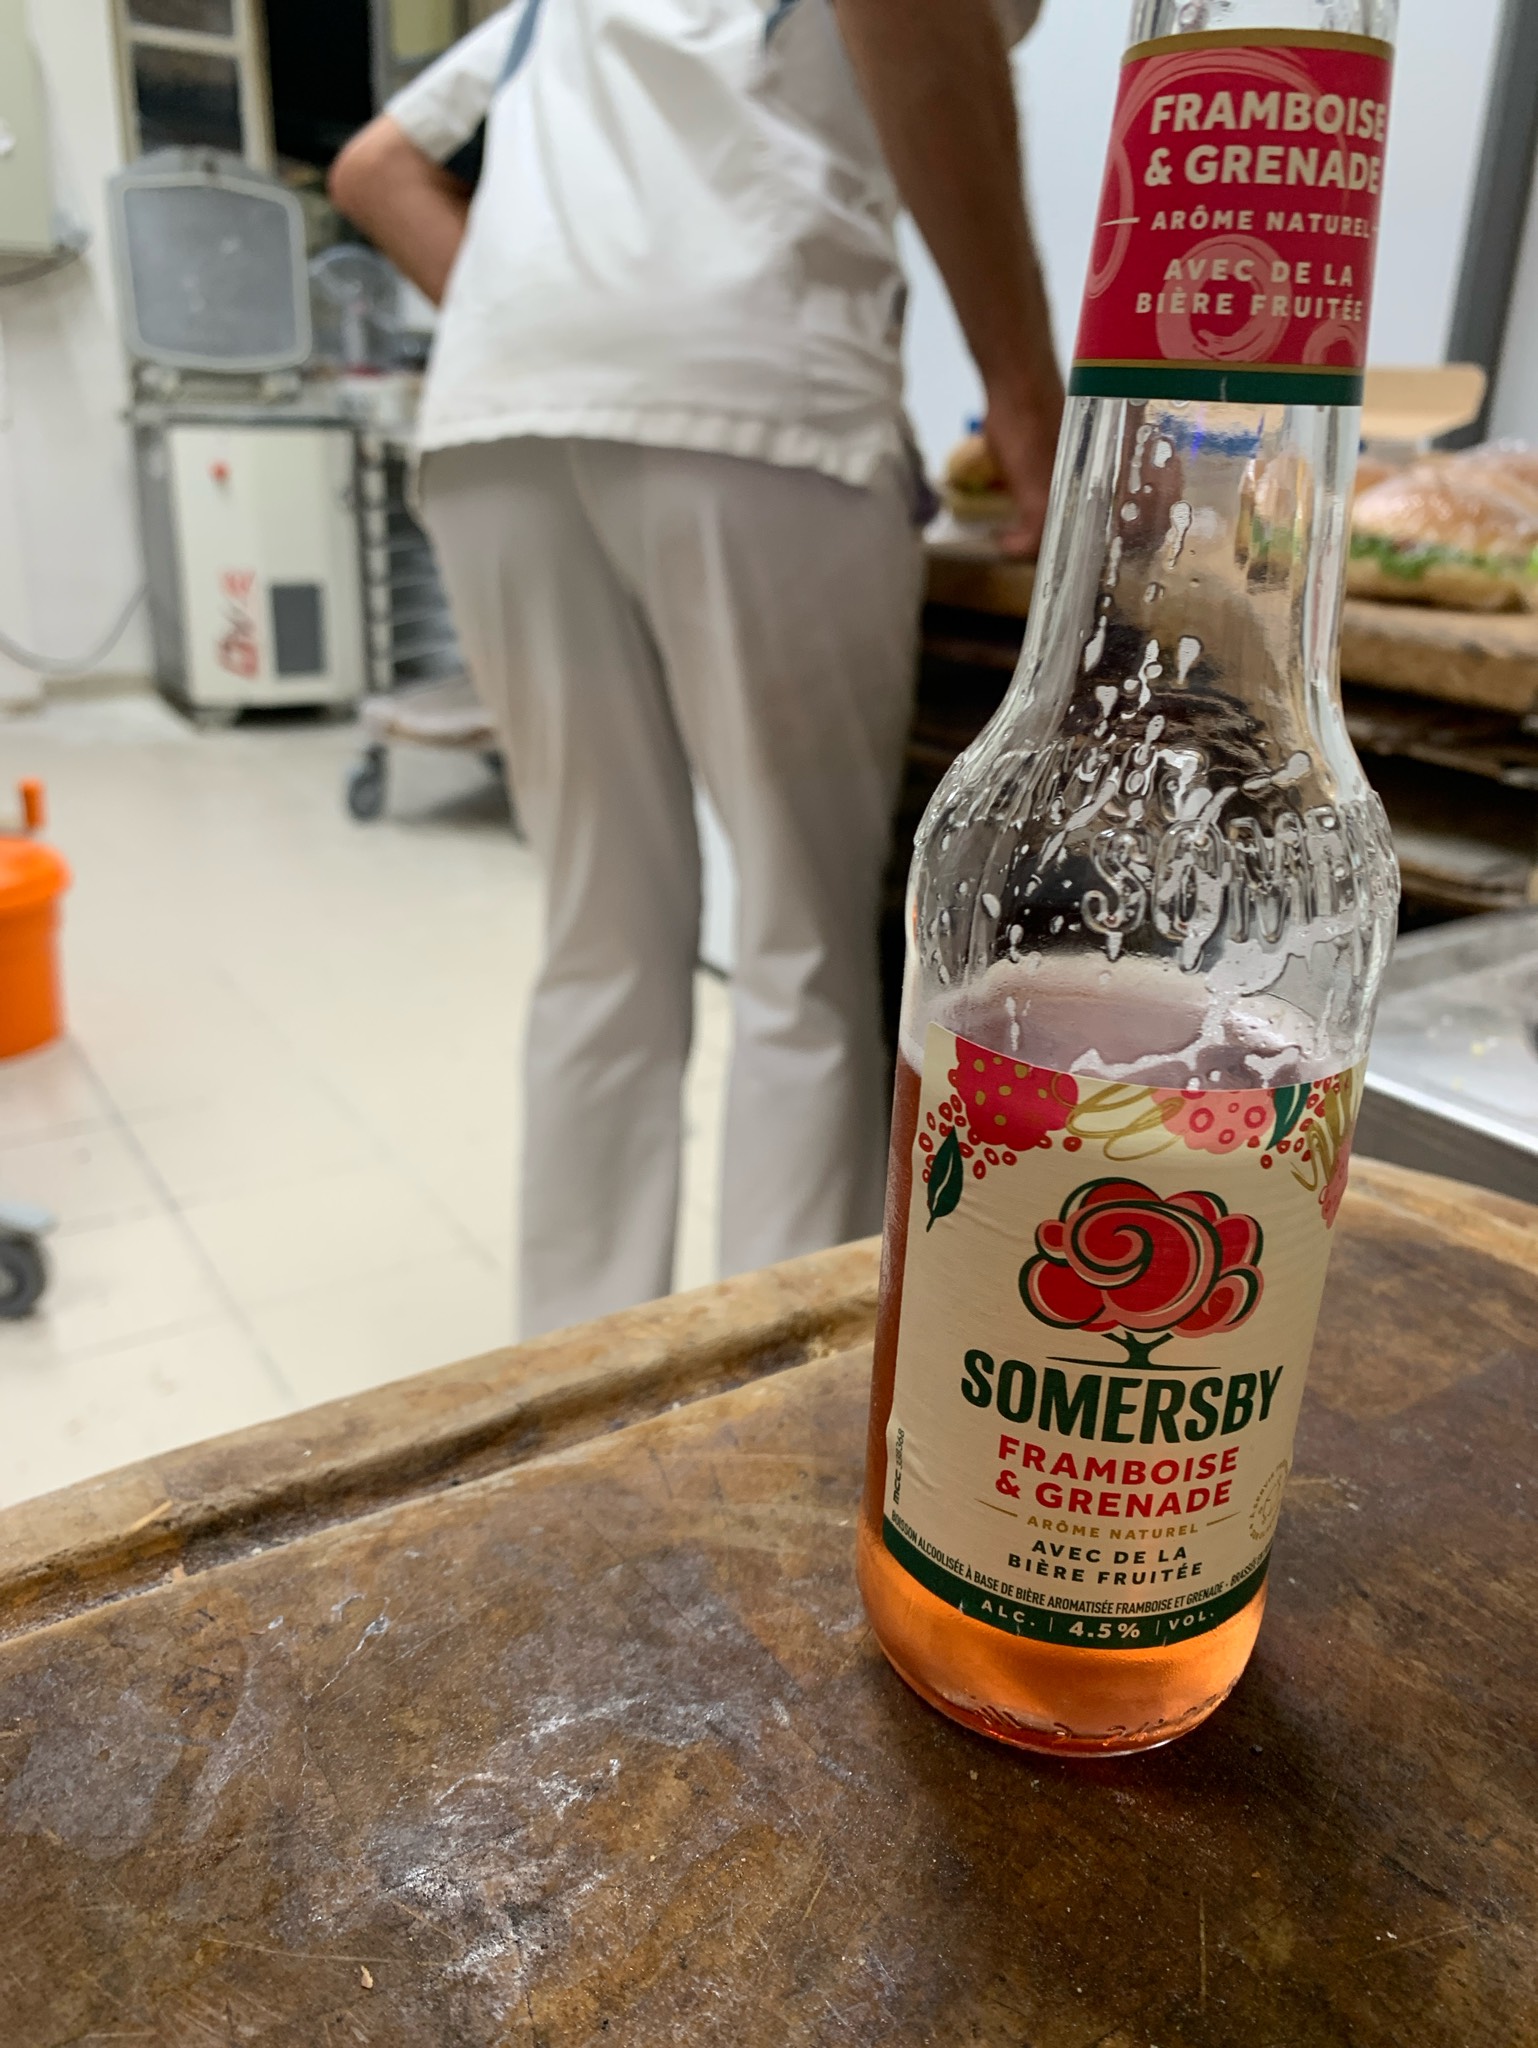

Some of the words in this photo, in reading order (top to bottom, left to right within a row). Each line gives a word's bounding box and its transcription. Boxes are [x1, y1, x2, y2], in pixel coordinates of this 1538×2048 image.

[1150, 91, 1387, 142] FRAMBOISE
[1144, 147, 1173, 187] &
[1184, 145, 1381, 195] GRENADE
[1151, 204, 1255, 231] ARÔME
[1266, 211, 1370, 238] NATUREL
[1163, 258, 1256, 282] AVEC
[1270, 260, 1312, 285] DE
[1323, 262, 1354, 288] LA
[1134, 286, 1235, 316] BIÈRE
[1250, 292, 1363, 323] FRUITÉE
[961, 1348, 1284, 1445] SOMERSBY
[998, 1434, 1240, 1486] FRAMBOISE
[995, 1469, 1021, 1500] &
[1034, 1479, 1233, 1518] GRENADE
[1027, 1515, 1100, 1539] ARÔME
[1109, 1523, 1199, 1541] NATUREL
[891, 1509, 918, 1545] BOISSON
[917, 1536, 964, 1576] ALCOOLISÉE
[965, 1563, 973, 1580] À
[974, 1570, 999, 1592] BASE
[1001, 1582, 1015, 1597] DE
[1015, 1587, 1047, 1606] BIÈRE
[1047, 1594, 1114, 1615] AROMATISÉE
[1115, 1597, 1173, 1615] FRAMBOISE
[1174, 1595, 1185, 1609] ET
[1186, 1581, 1225, 1606] GRENADE
[1007, 1553, 1085, 1582] BIÈRE
[1097, 1562, 1203, 1586] FRUITÉE
[1032, 1539, 1101, 1564] AVEC
[1113, 1550, 1146, 1565] DE
[1158, 1546, 1187, 1563] LA
[981, 1599, 1035, 1627] ALC.
[1068, 1620, 1141, 1639] 4.5%
[1168, 1610, 1215, 1631] VOL.
